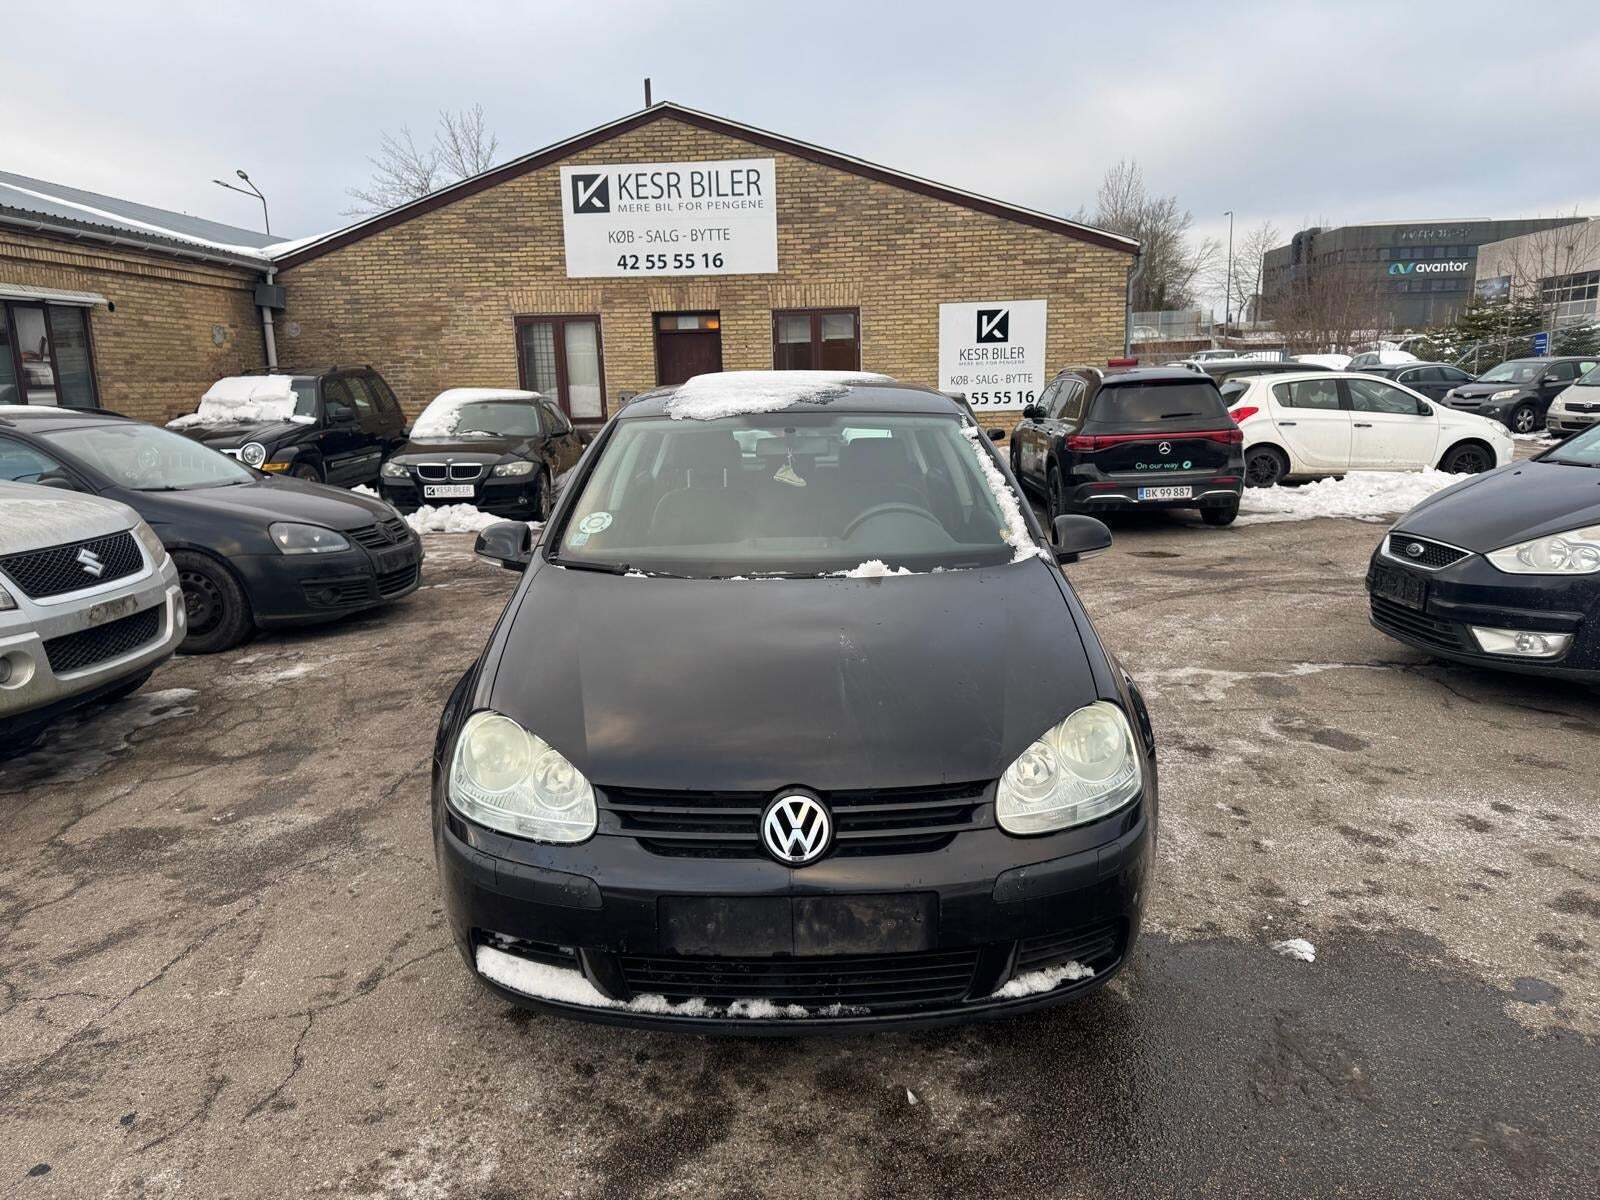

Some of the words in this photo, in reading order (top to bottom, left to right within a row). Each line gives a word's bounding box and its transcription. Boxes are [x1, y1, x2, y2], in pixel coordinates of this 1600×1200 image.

[618, 172, 682, 200] KESR
[691, 169, 761, 198] BILER
[618, 203, 650, 212] MERE
[655, 203, 673, 211] BIL
[678, 202, 702, 211] FOR
[707, 200, 764, 210] PENGENE
[608, 230, 635, 243] KØB
[646, 229, 679, 242] SALG
[690, 228, 730, 241] BYTTE
[617, 254, 640, 270] 42
[645, 254, 667, 270] 55
[673, 253, 695, 269] 55
[701, 252, 724, 269] 16
[1416, 261, 1469, 272] avantor
[959, 348, 989, 361] KESR
[992, 346, 1025, 360] BILER
[950, 375, 969, 385] KØB
[975, 374, 998, 384] SALG
[1005, 373, 1033, 383] BYTTE
[971, 392, 989, 405] 55
[993, 391, 1011, 404] 55
[1017, 390, 1035, 403] 16
[1145, 489, 1158, 497] BK
[1160, 488, 1172, 497] 99
[1173, 487, 1191, 496] 887
